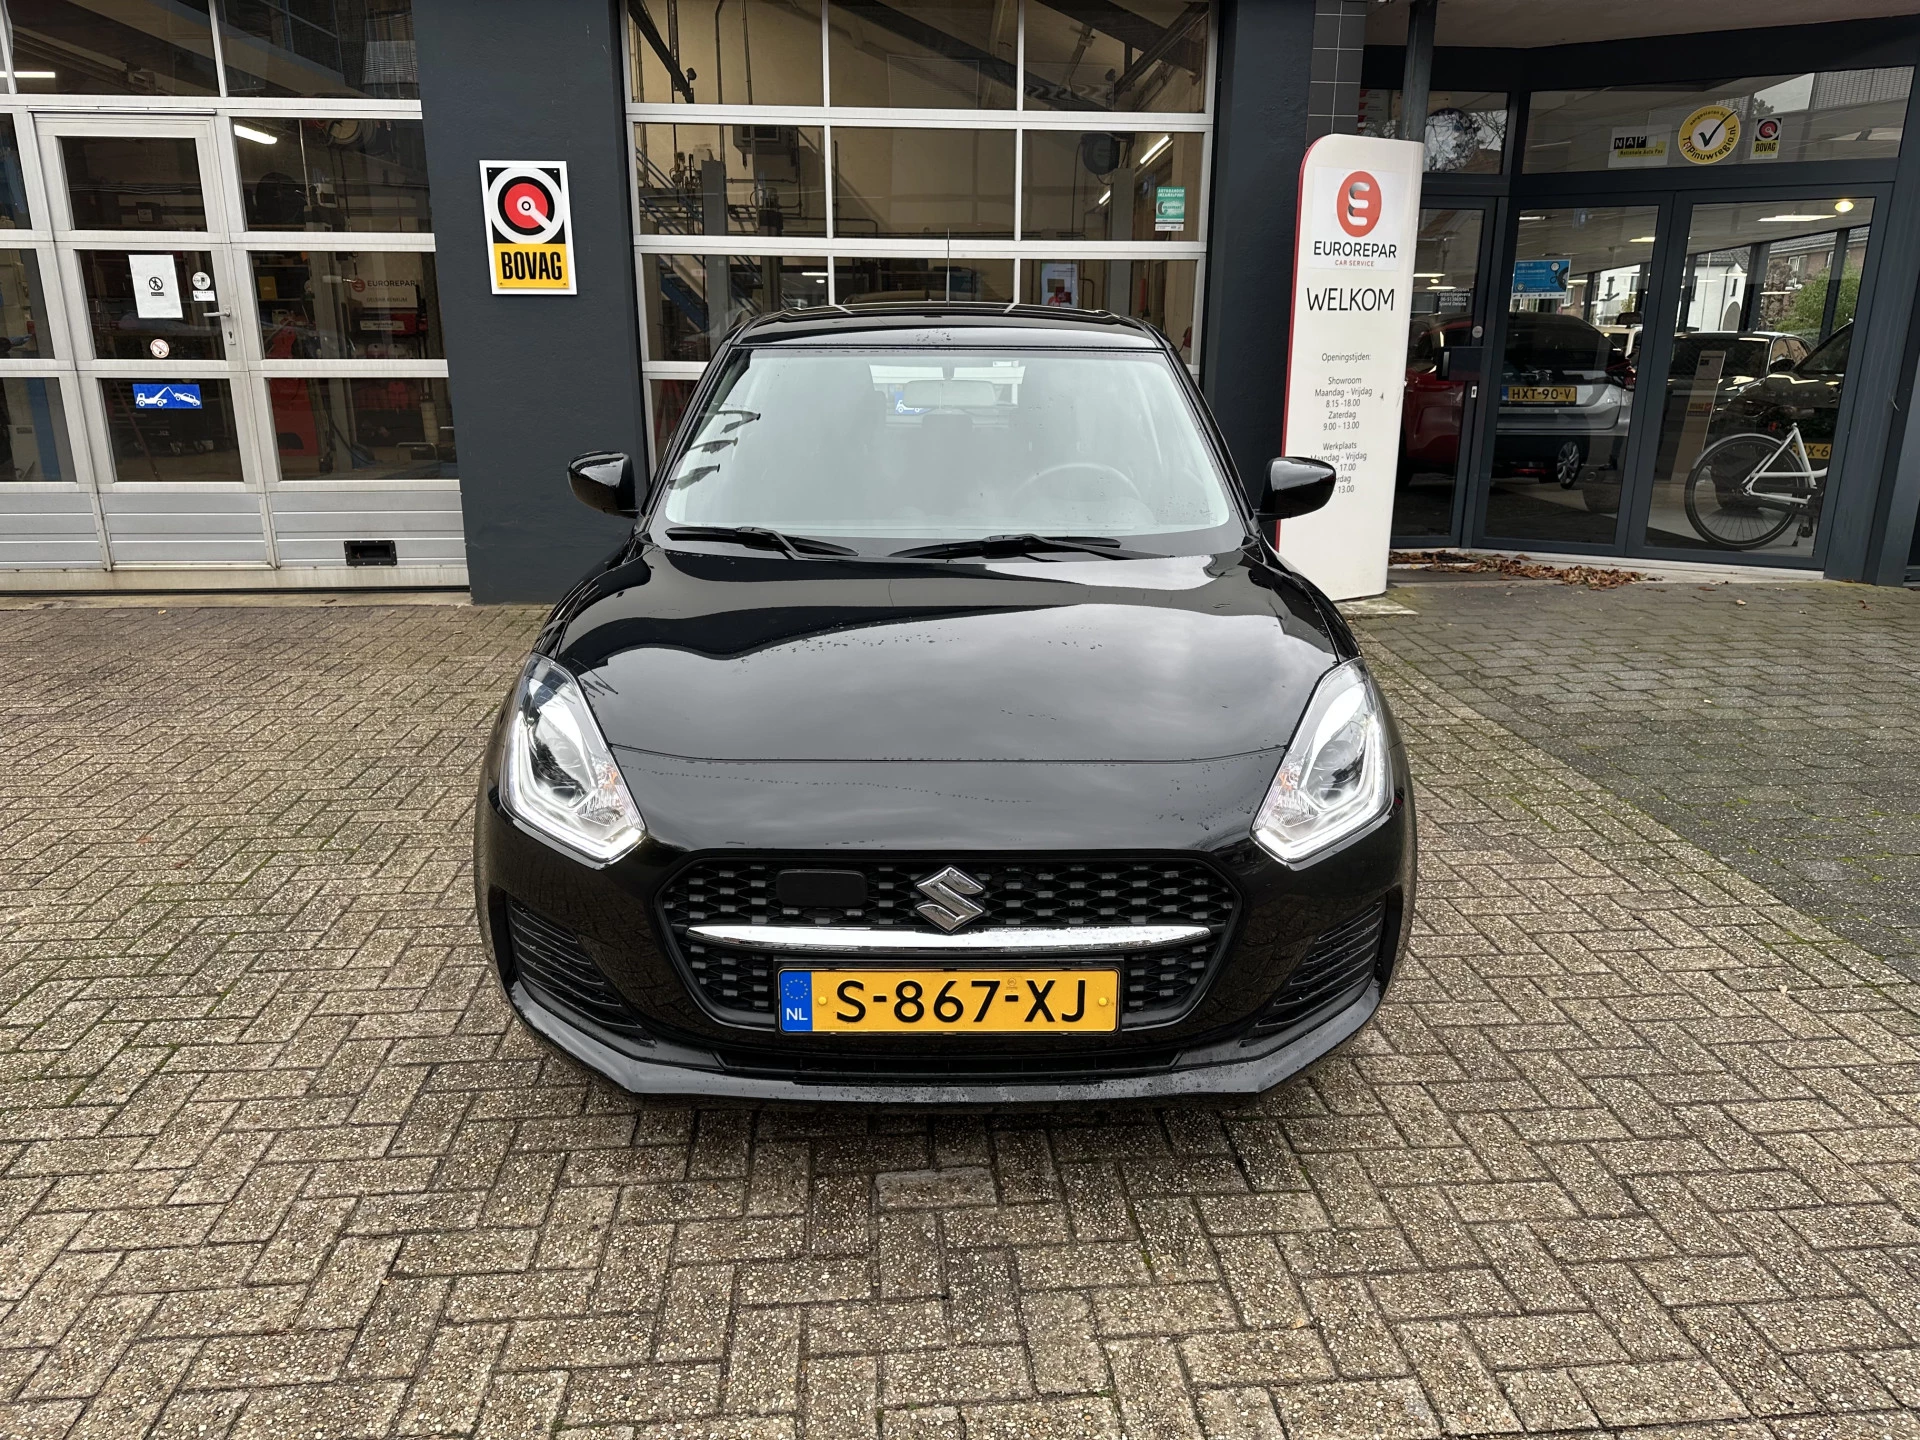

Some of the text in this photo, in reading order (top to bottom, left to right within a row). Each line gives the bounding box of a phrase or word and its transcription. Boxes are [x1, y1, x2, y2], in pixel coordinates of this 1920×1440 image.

[1755, 142, 1777, 152] BOVAG
[1314, 241, 1397, 258] EUROREPAR
[500, 251, 562, 280] BOVAG
[1307, 288, 1395, 311] WELKOM
[1321, 352, 1371, 363] Openingstijden:
[1328, 377, 1362, 385] Showroom
[1315, 388, 1345, 398] Maandag
[1351, 387, 1373, 397] Vrijdag
[1512, 388, 1571, 400] HXT-90-V
[1325, 400, 1339, 408] 8.15
[1328, 410, 1357, 420] Zaterdag
[1323, 422, 1337, 431] 9.00
[1343, 421, 1360, 430] 13.00
[1323, 441, 1357, 451] Werkplaats
[1346, 452, 1367, 461] Vrijdag
[1339, 463, 1356, 471] 17.00
[1338, 485, 1355, 493] 13.00
[836, 979, 1086, 1023] S-867-XJ
[786, 1008, 808, 1021] NL
